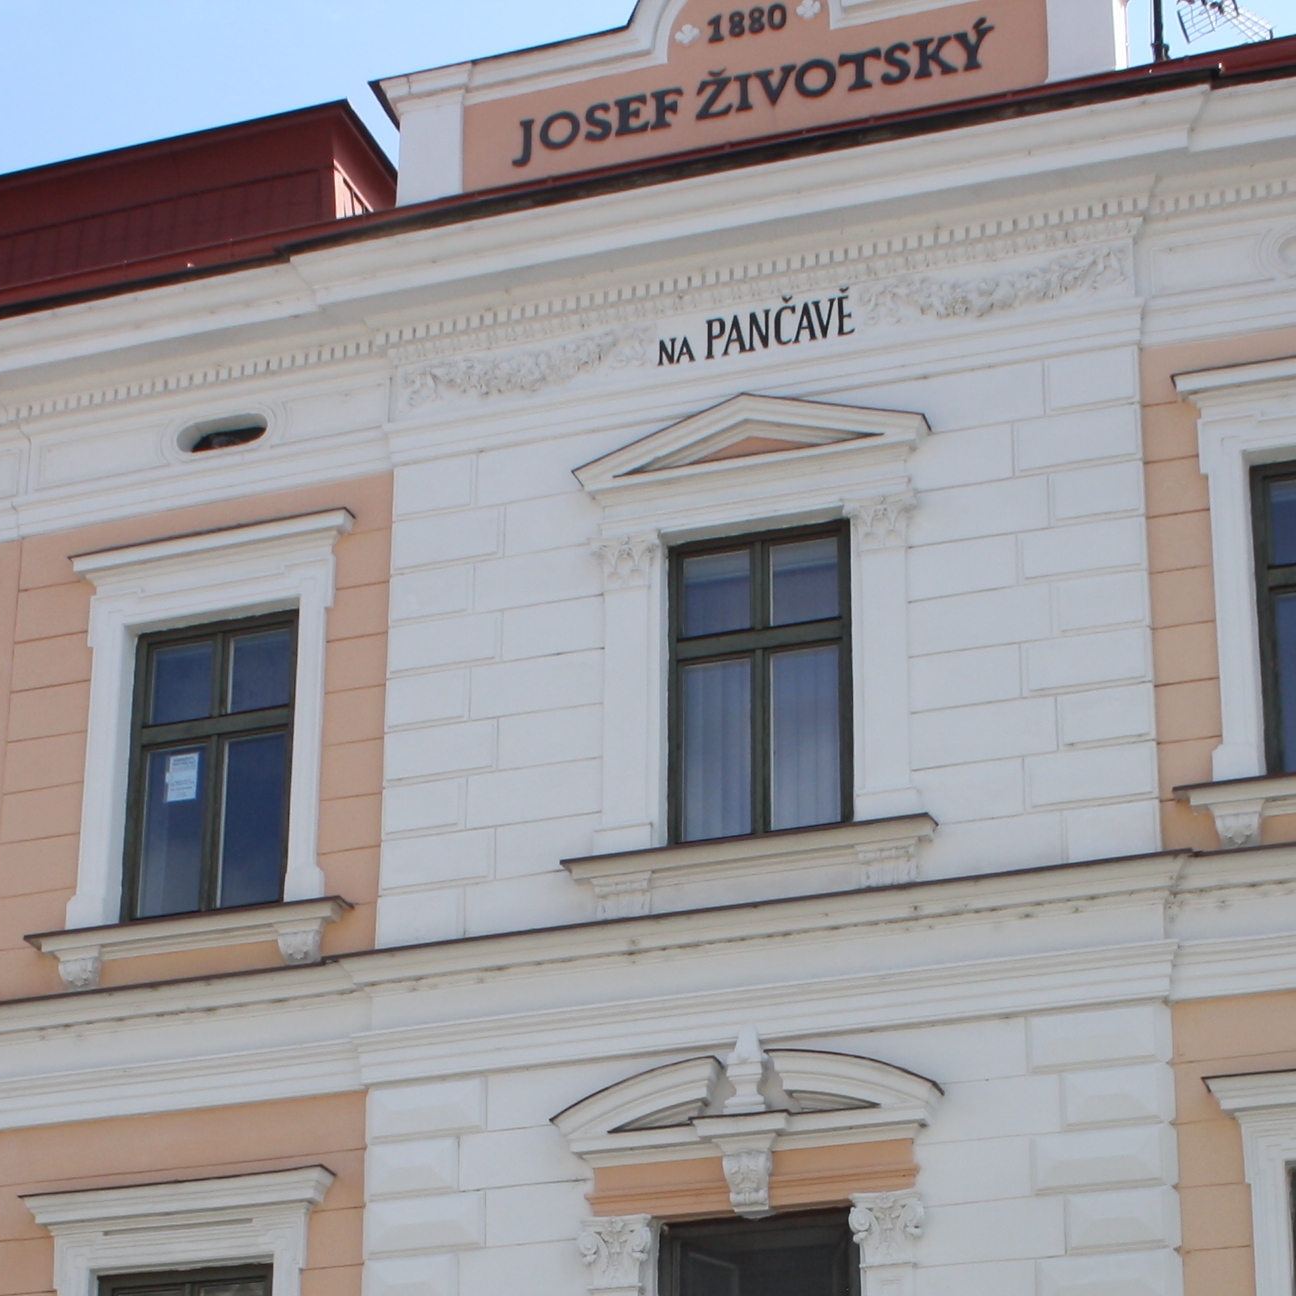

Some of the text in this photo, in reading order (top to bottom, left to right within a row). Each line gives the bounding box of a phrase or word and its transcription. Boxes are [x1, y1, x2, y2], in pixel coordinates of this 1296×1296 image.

[707, 3, 787, 44] 1880
[511, 17, 996, 168] JOSEF ŽIVOTSKÝ
[657, 286, 857, 367] NA PANČAVĚ
